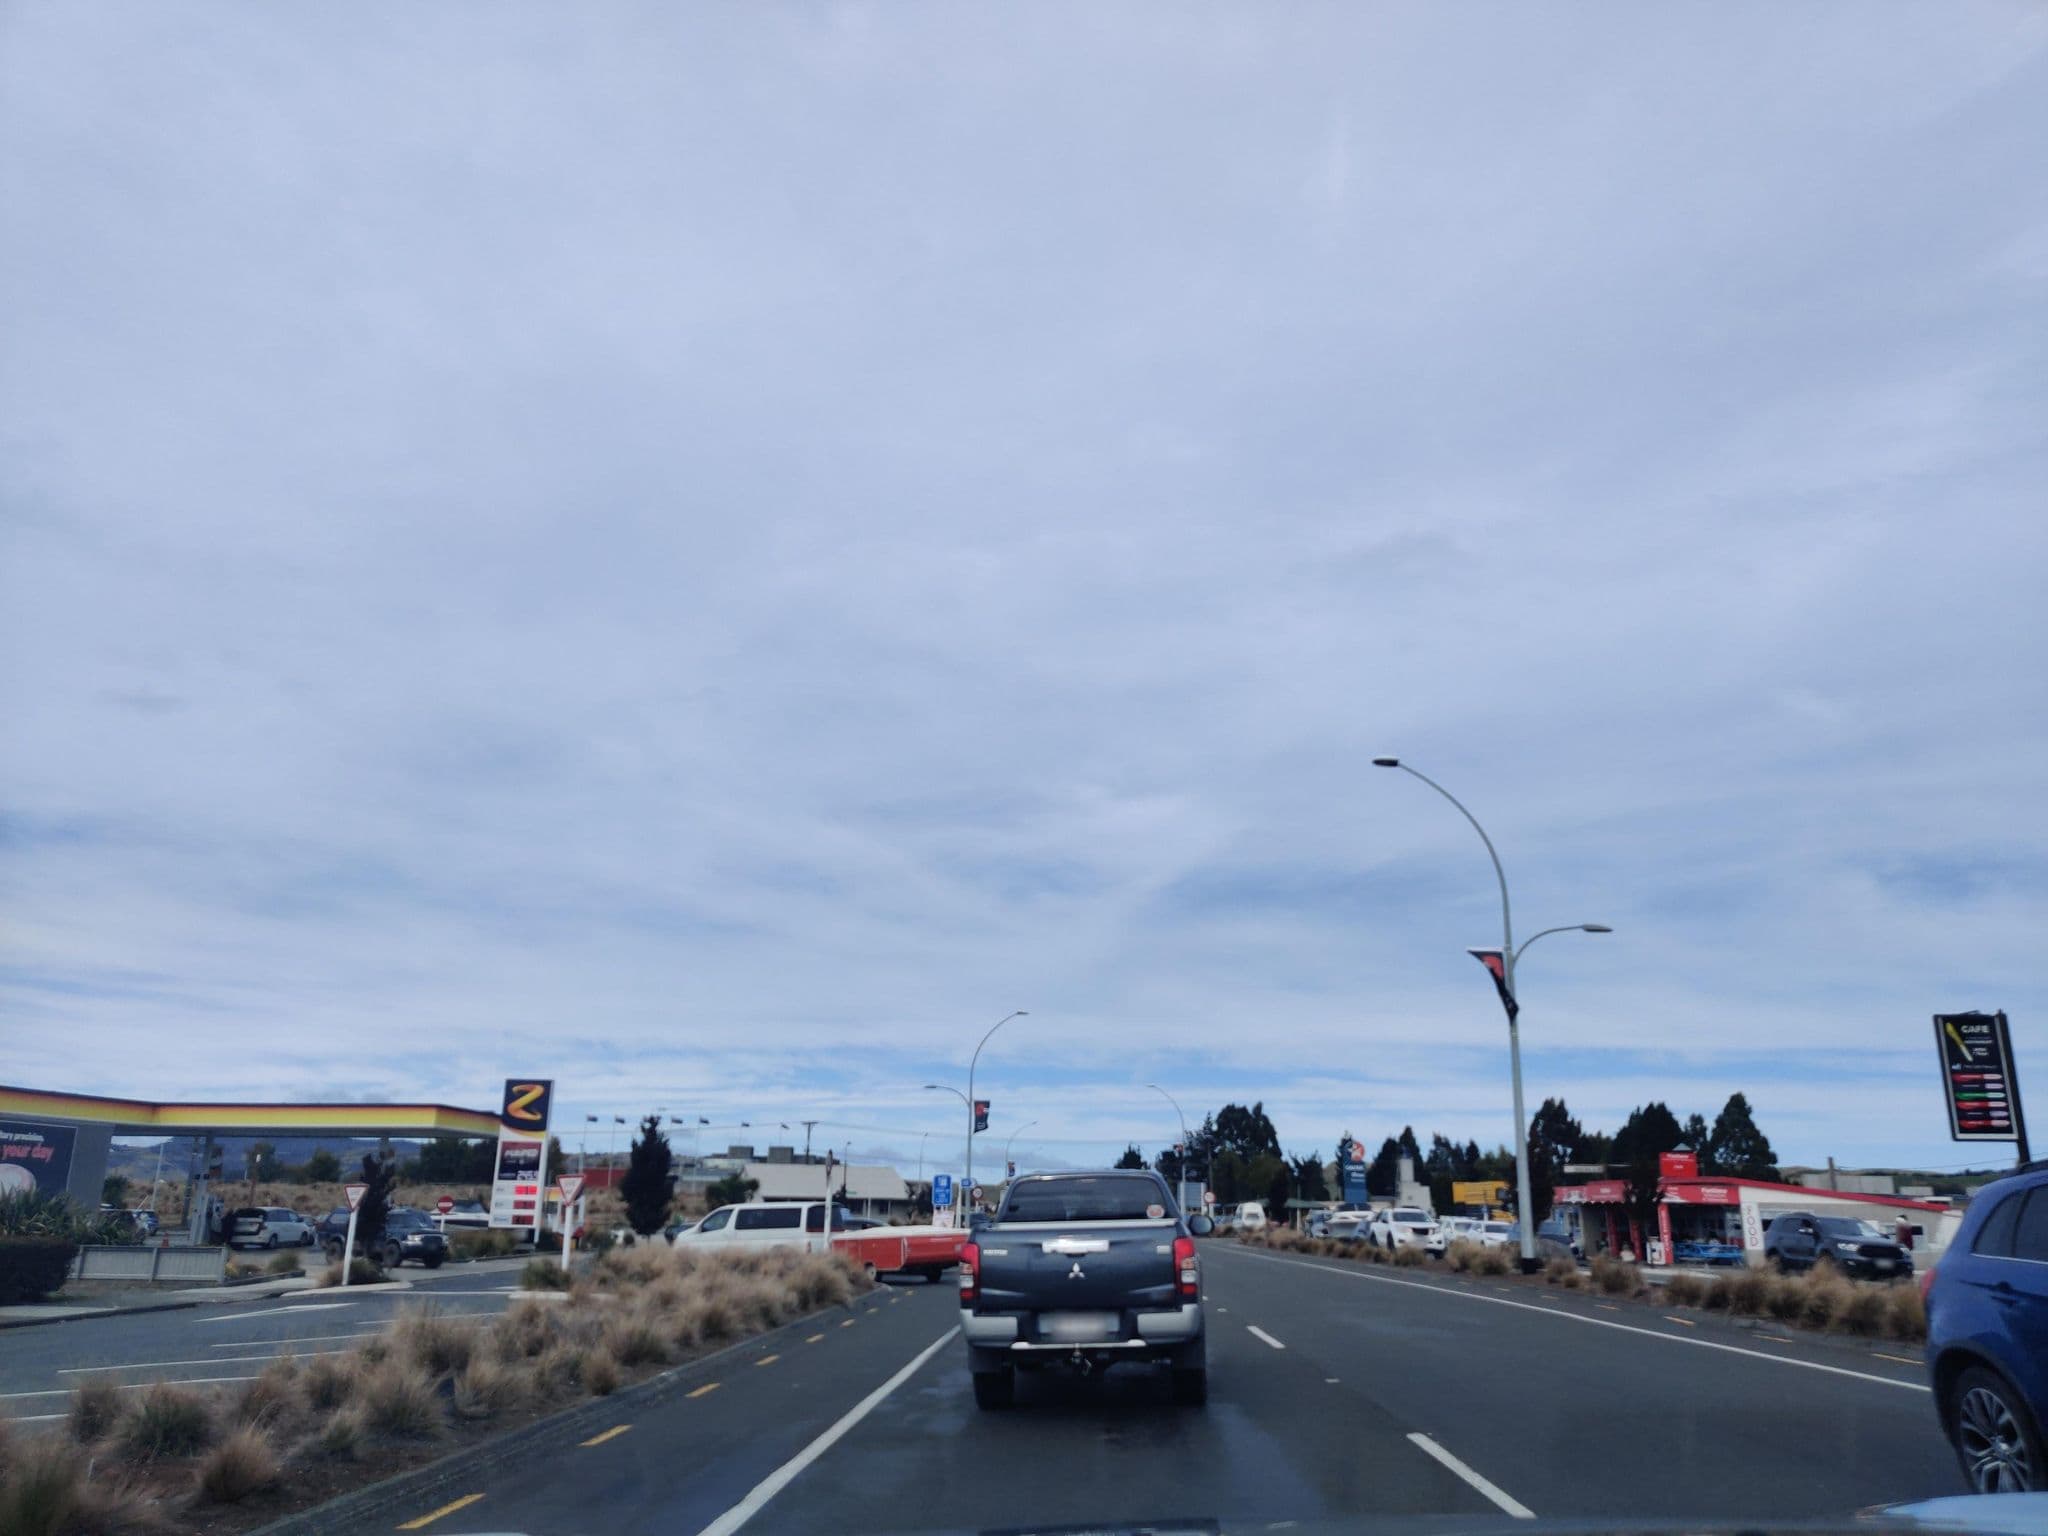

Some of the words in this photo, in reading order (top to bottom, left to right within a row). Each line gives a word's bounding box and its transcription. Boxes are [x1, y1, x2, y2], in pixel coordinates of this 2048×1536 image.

[1961, 1025, 1990, 1033] CAFE
[507, 1084, 544, 1120] Z
[2, 1144, 30, 1160] your
[32, 1143, 54, 1163] day
